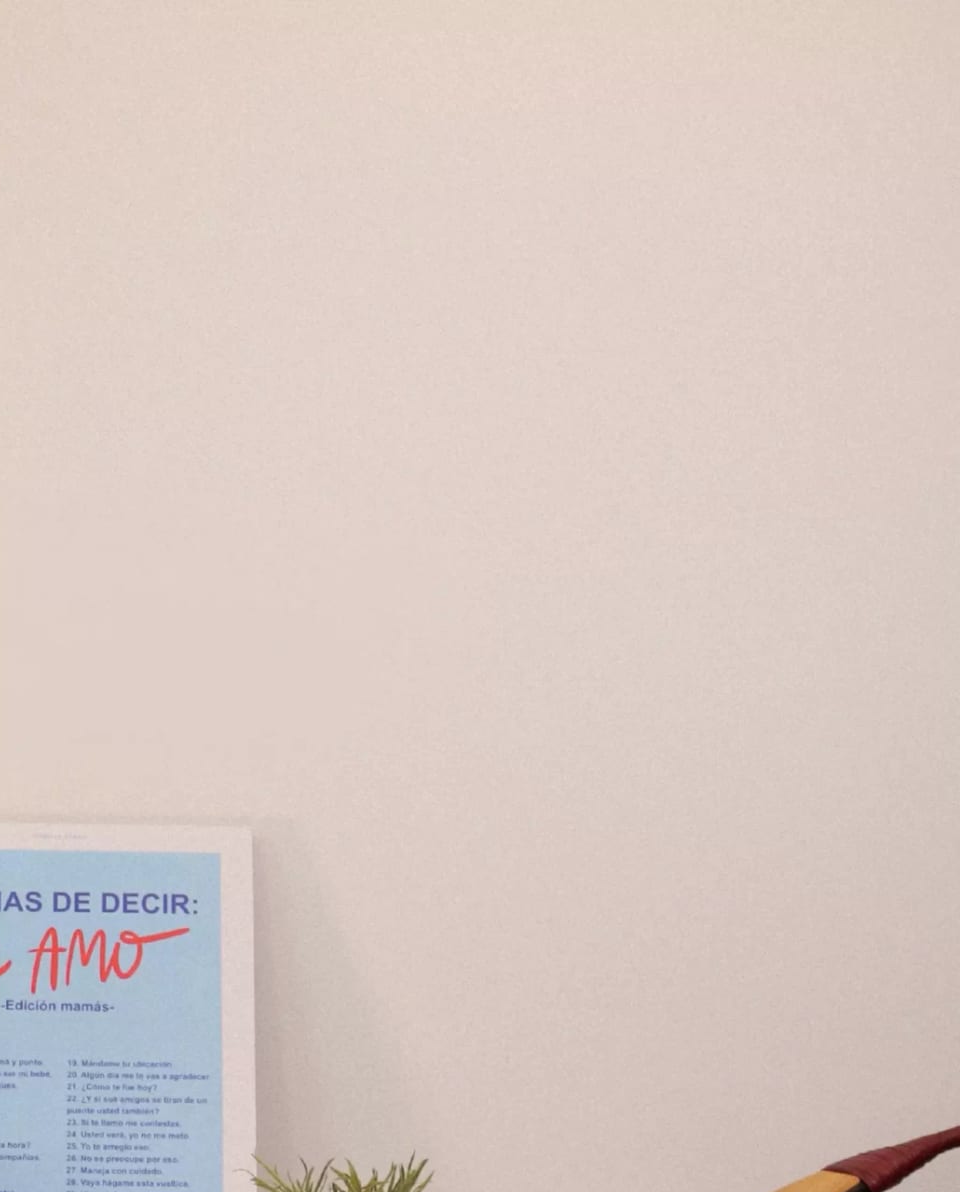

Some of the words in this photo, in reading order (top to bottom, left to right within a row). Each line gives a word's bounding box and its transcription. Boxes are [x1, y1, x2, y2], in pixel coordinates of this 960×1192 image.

[52, 891, 91, 913] DE
[101, 892, 199, 915] DECIR:
[28, 926, 190, 994] AMO
[0, 999, 57, 1012] -Edición
[60, 1000, 115, 1012] mamás-
